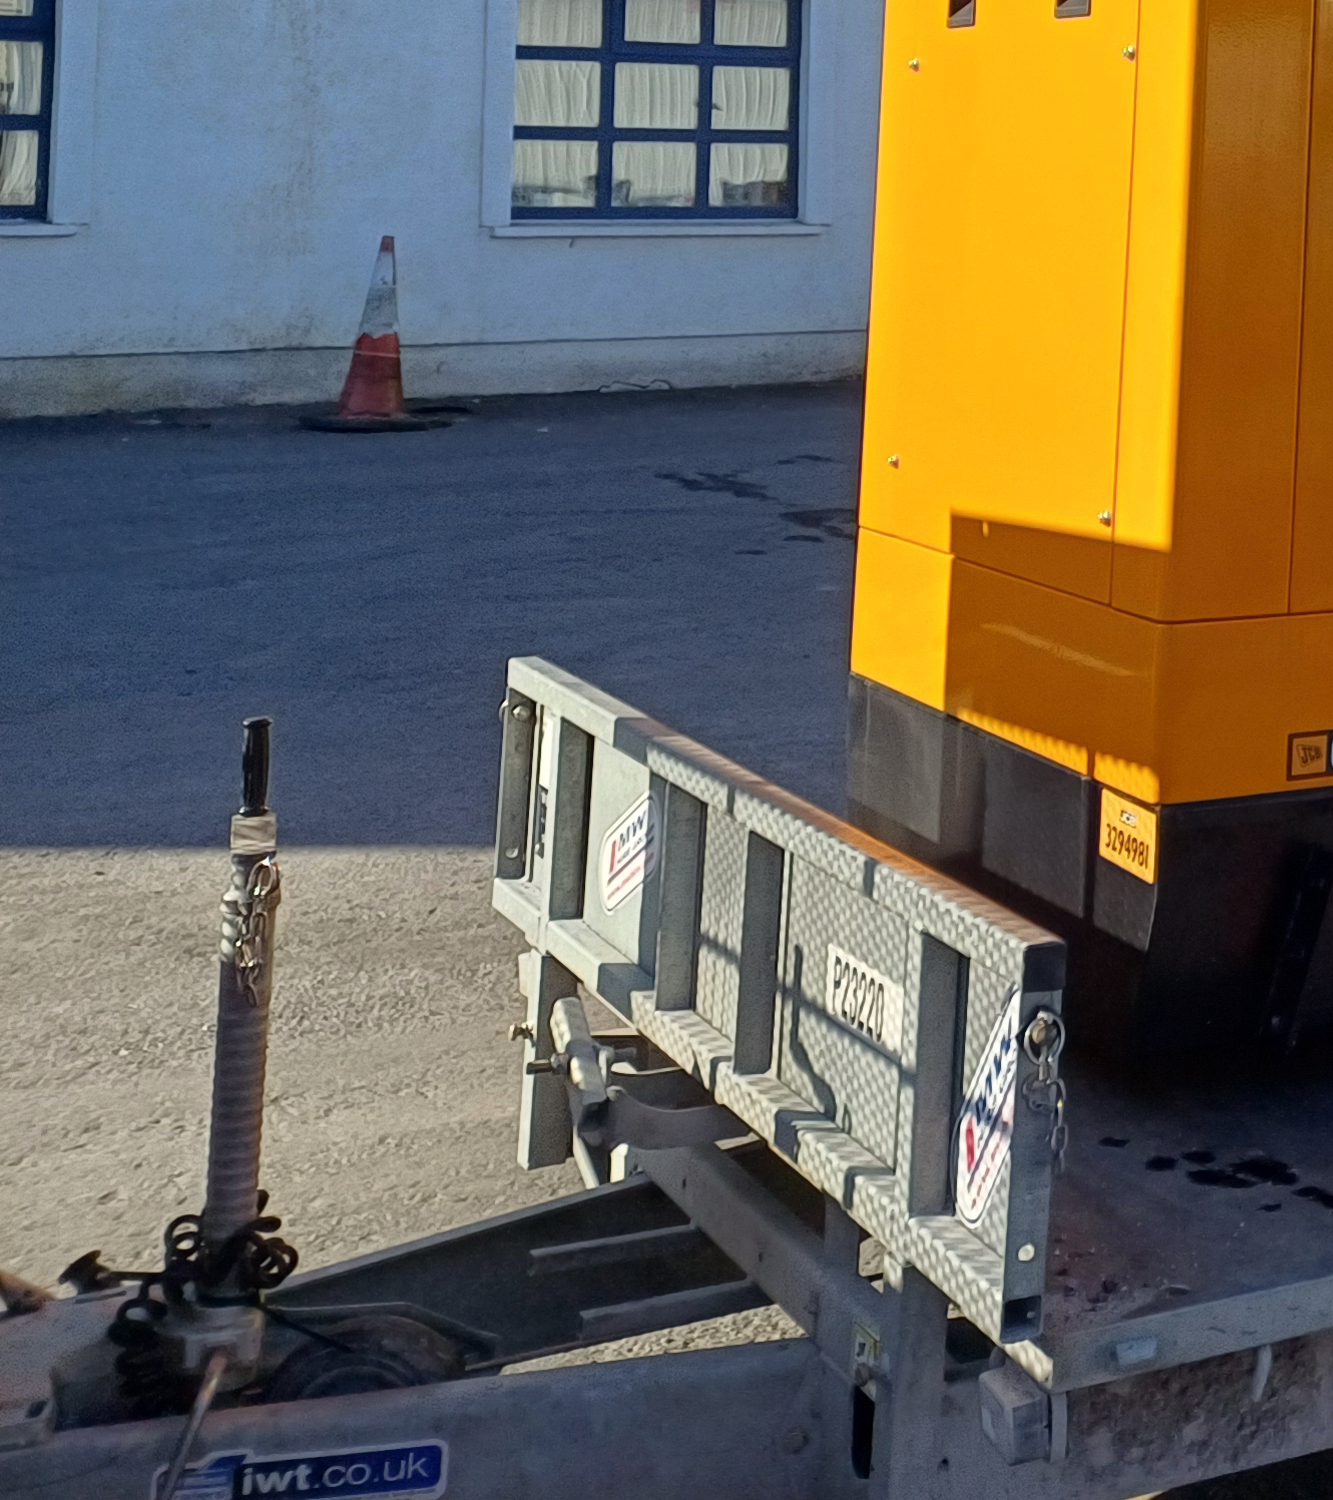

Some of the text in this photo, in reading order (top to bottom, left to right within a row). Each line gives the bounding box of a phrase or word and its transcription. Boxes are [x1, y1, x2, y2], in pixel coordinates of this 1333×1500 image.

[1105, 823, 1149, 870] 3294981
[833, 955, 885, 1042] P23220
[242, 1452, 430, 1496] iwt.co.uk
